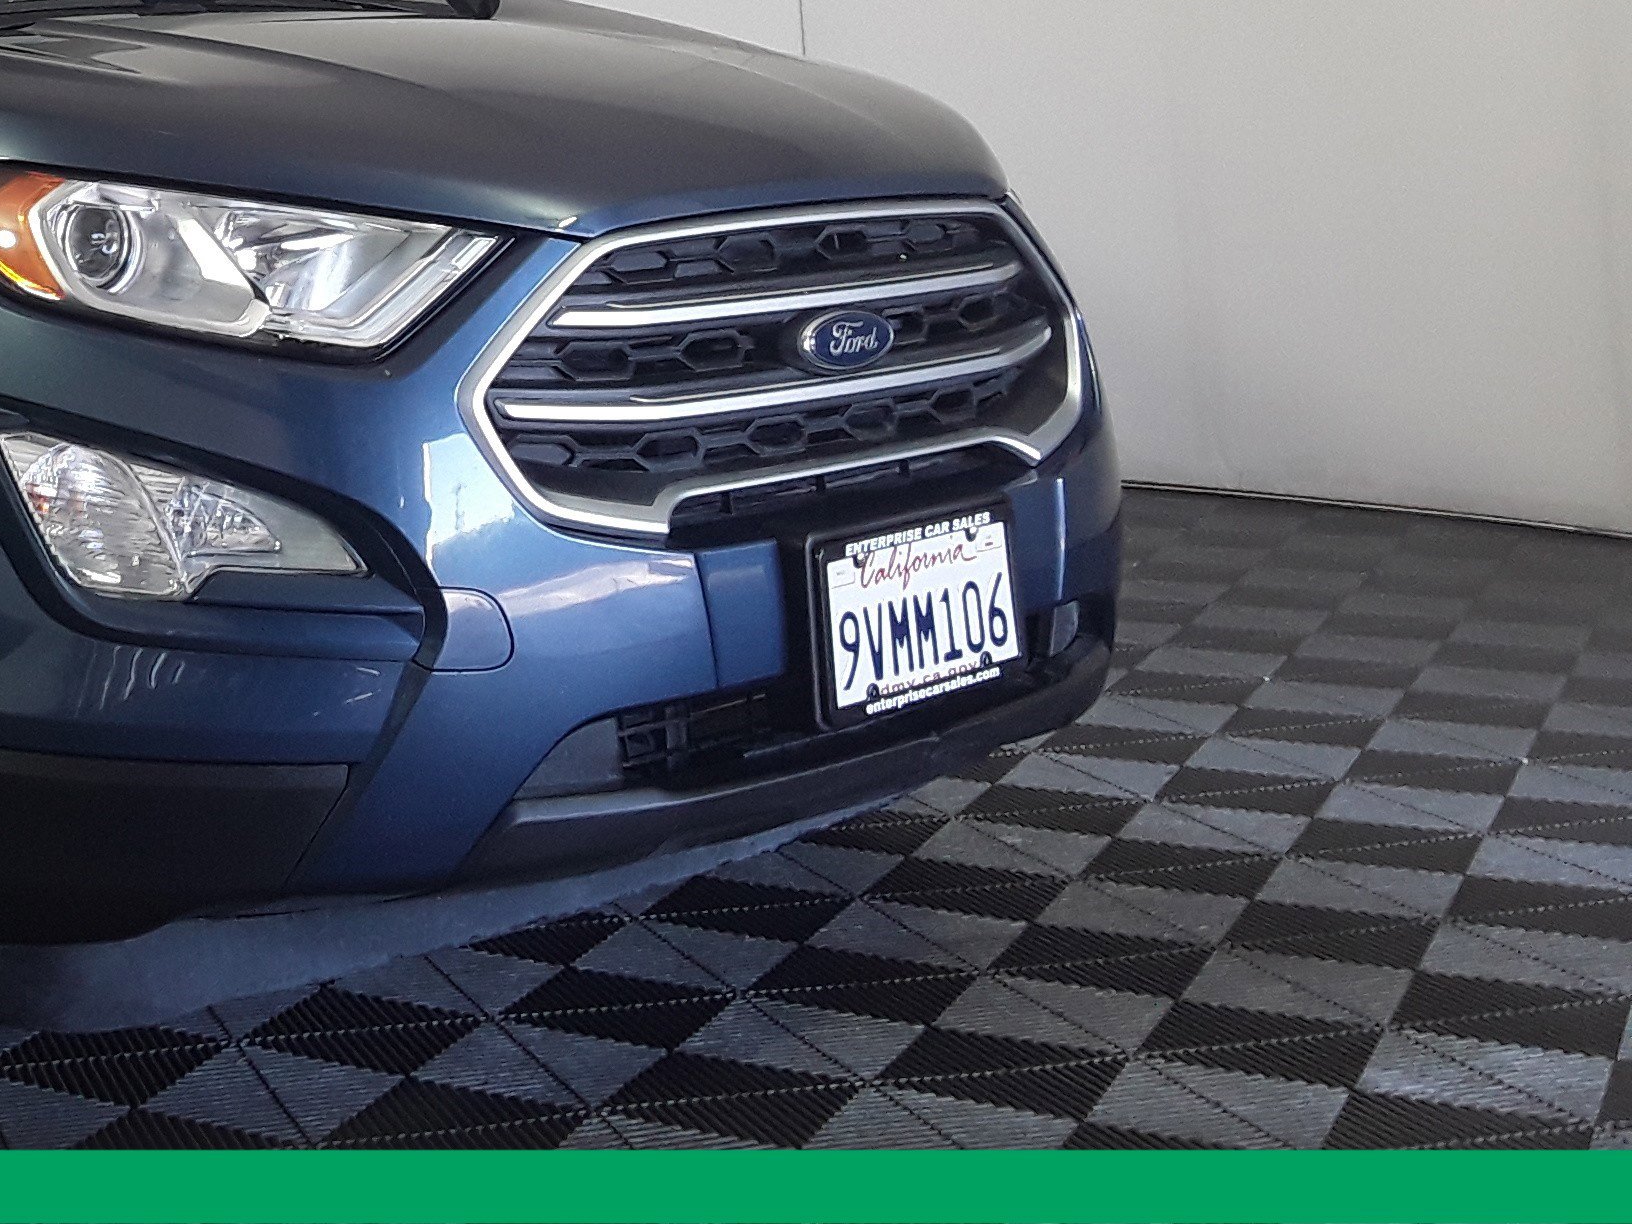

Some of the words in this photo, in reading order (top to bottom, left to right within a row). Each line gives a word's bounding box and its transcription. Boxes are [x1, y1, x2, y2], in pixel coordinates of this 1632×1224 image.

[829, 320, 879, 357] Ford
[845, 528, 922, 557] ENTERPRISE
[924, 521, 950, 538] CAR
[951, 512, 992, 532] SALES
[859, 542, 978, 591] California
[838, 571, 1009, 692] 9VMM106
[865, 665, 1001, 716] enterprisecarsales.com
